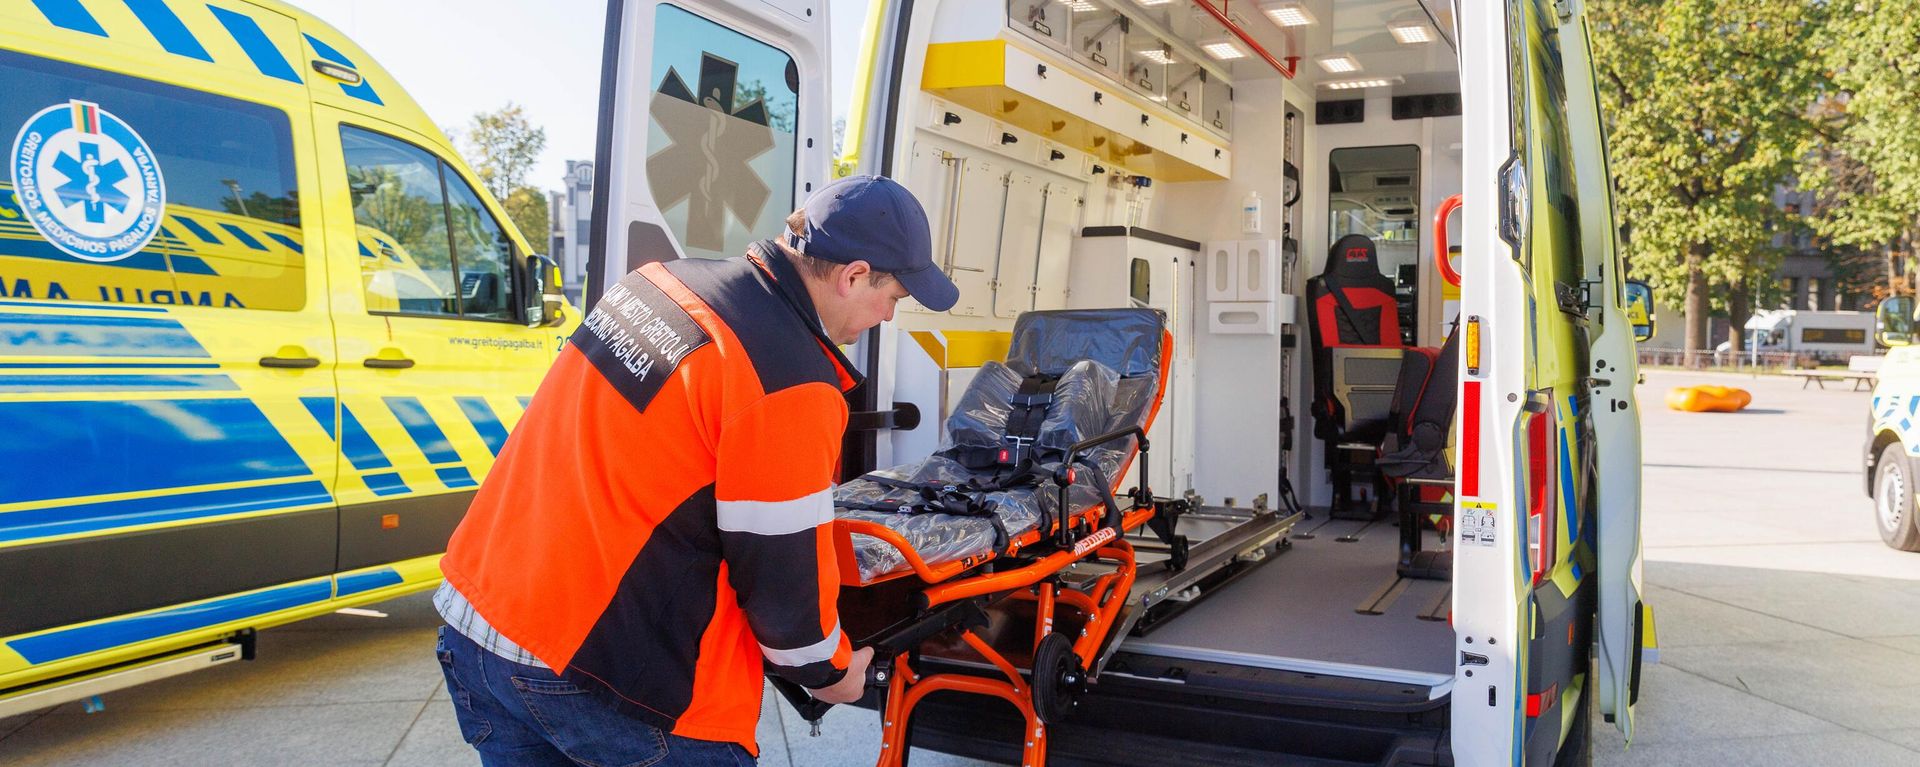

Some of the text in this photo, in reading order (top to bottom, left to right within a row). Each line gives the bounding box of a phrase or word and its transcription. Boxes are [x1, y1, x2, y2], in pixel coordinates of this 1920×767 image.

[18, 131, 161, 253] GREITOSIOS MEDICINOS PAGALBOS TARNYBA
[448, 337, 543, 351] www.greitojipagalba.lt
[605, 329, 655, 382] PAGALBA
[639, 317, 690, 364] GREITOJI
